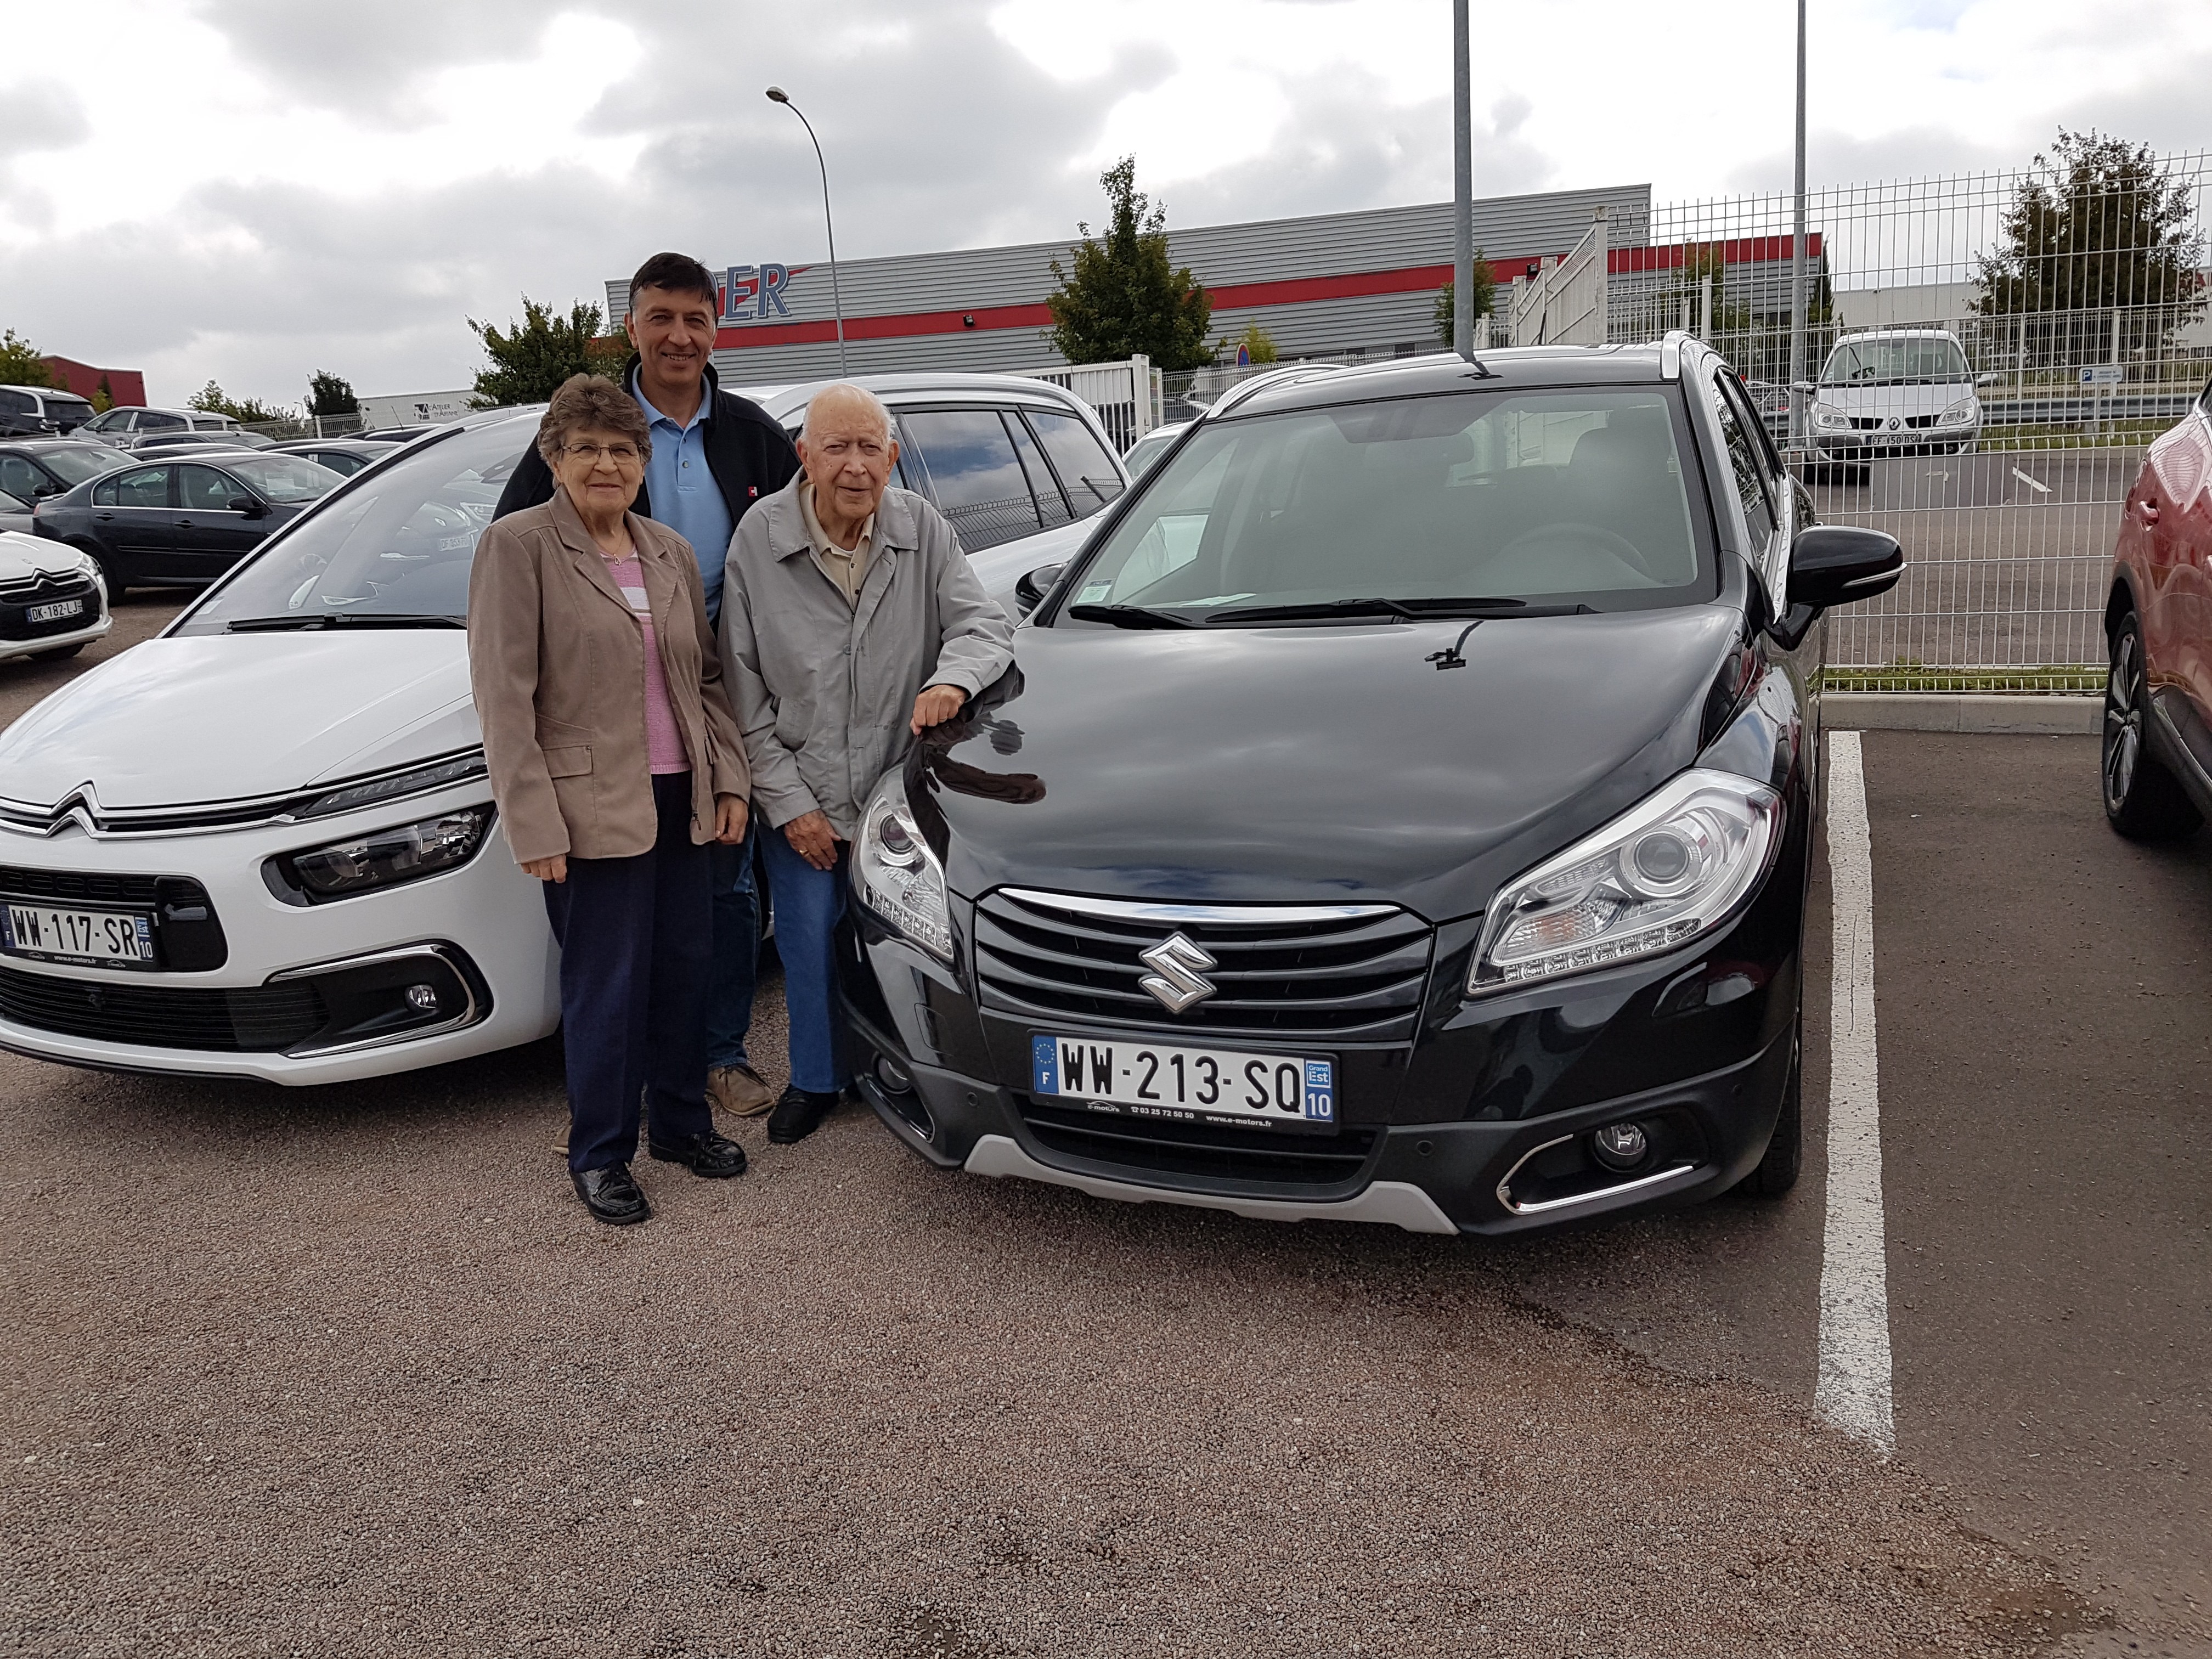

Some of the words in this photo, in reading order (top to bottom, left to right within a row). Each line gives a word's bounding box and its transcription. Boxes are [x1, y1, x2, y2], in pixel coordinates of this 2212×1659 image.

[714, 263, 791, 321] ER
[2083, 371, 2091, 380] P
[32, 601, 77, 620] DK-182-LJ
[12, 909, 138, 956] WW-117-SR
[139, 941, 153, 958] 10
[1042, 1071, 1050, 1085] F
[1062, 1043, 1300, 1114] WW-213-SQ
[1308, 1071, 1329, 1082] Est
[1308, 1093, 1331, 1116] 10
[1206, 1115, 1272, 1127] www.e-motors.fr
